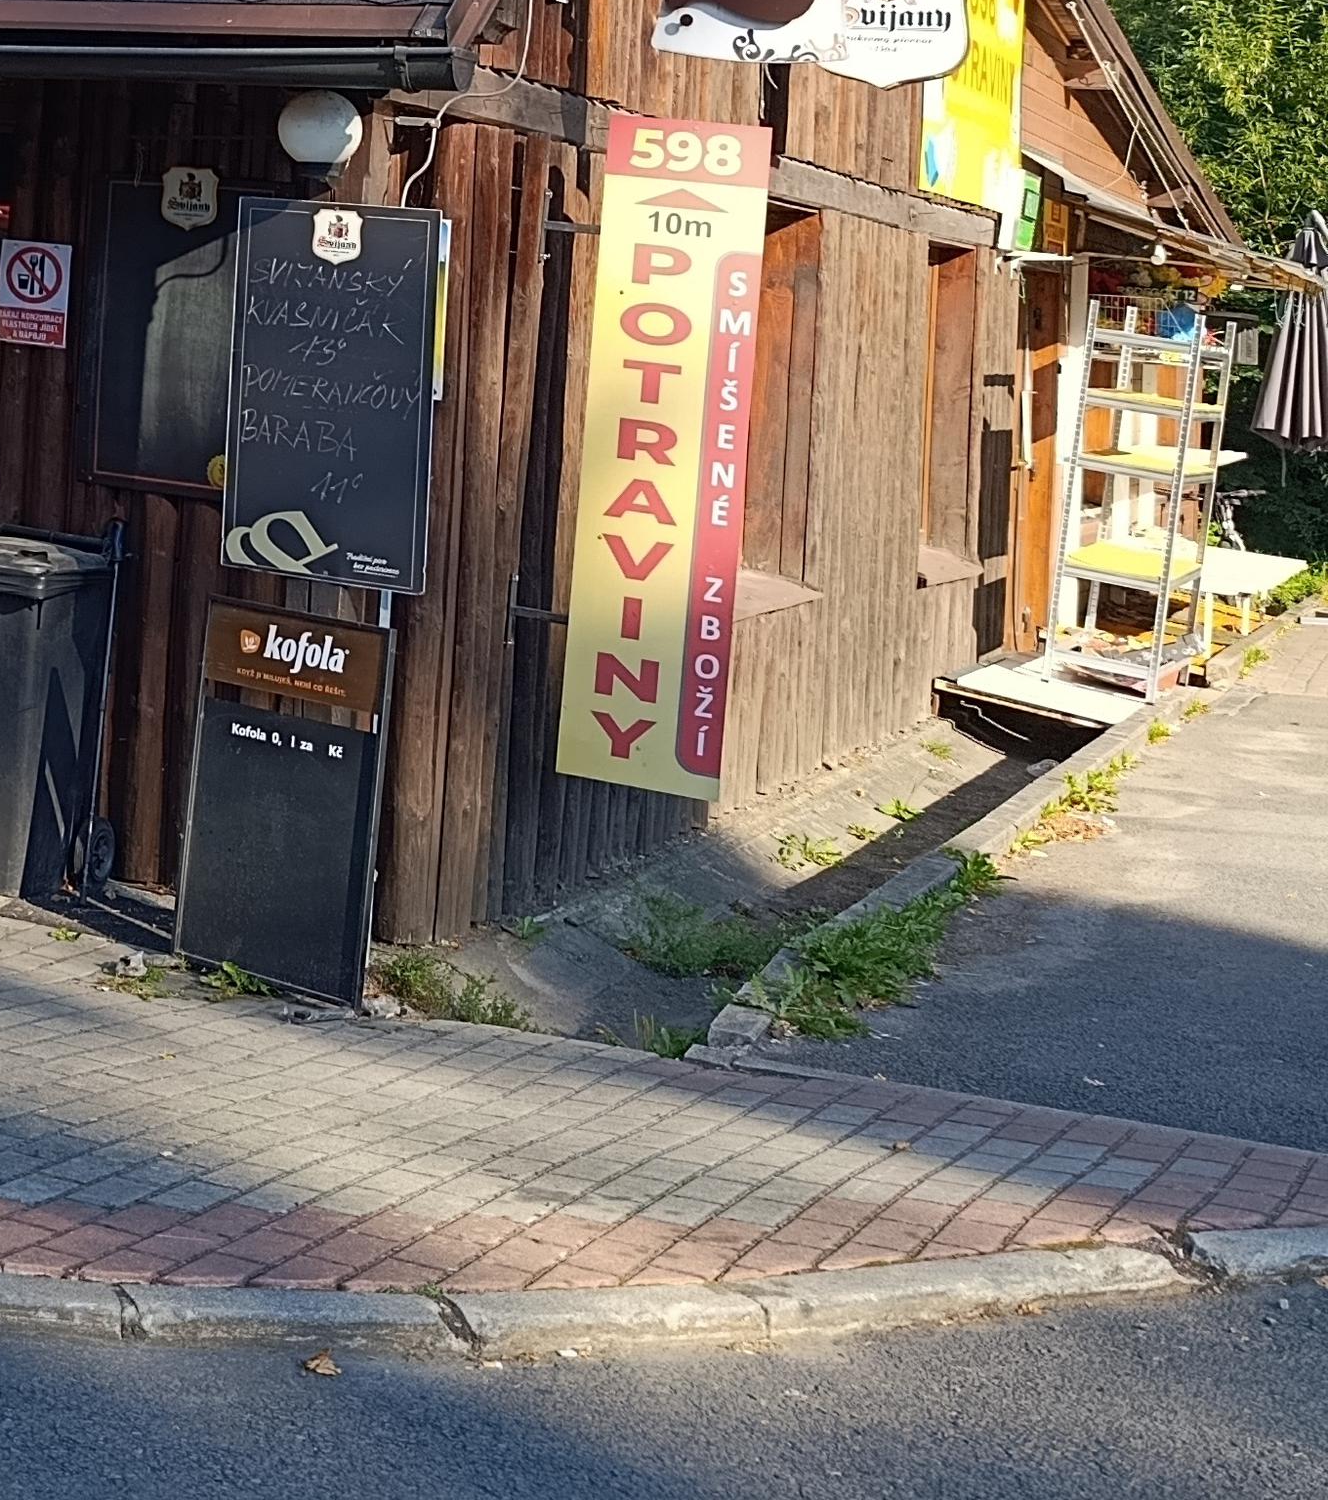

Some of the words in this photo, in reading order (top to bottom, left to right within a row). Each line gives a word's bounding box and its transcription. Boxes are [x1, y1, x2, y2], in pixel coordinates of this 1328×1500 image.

[629, 128, 742, 177] 598
[648, 211, 712, 238] 10m
[710, 270, 752, 528] SMÍŠENÉ
[592, 242, 693, 760] POTRAVINY
[263, 624, 345, 674] kofola
[692, 575, 724, 756] ZBOŽÍ
[231, 722, 267, 742] Kofola
[299, 740, 314, 752] za
[328, 744, 344, 759] Kč
